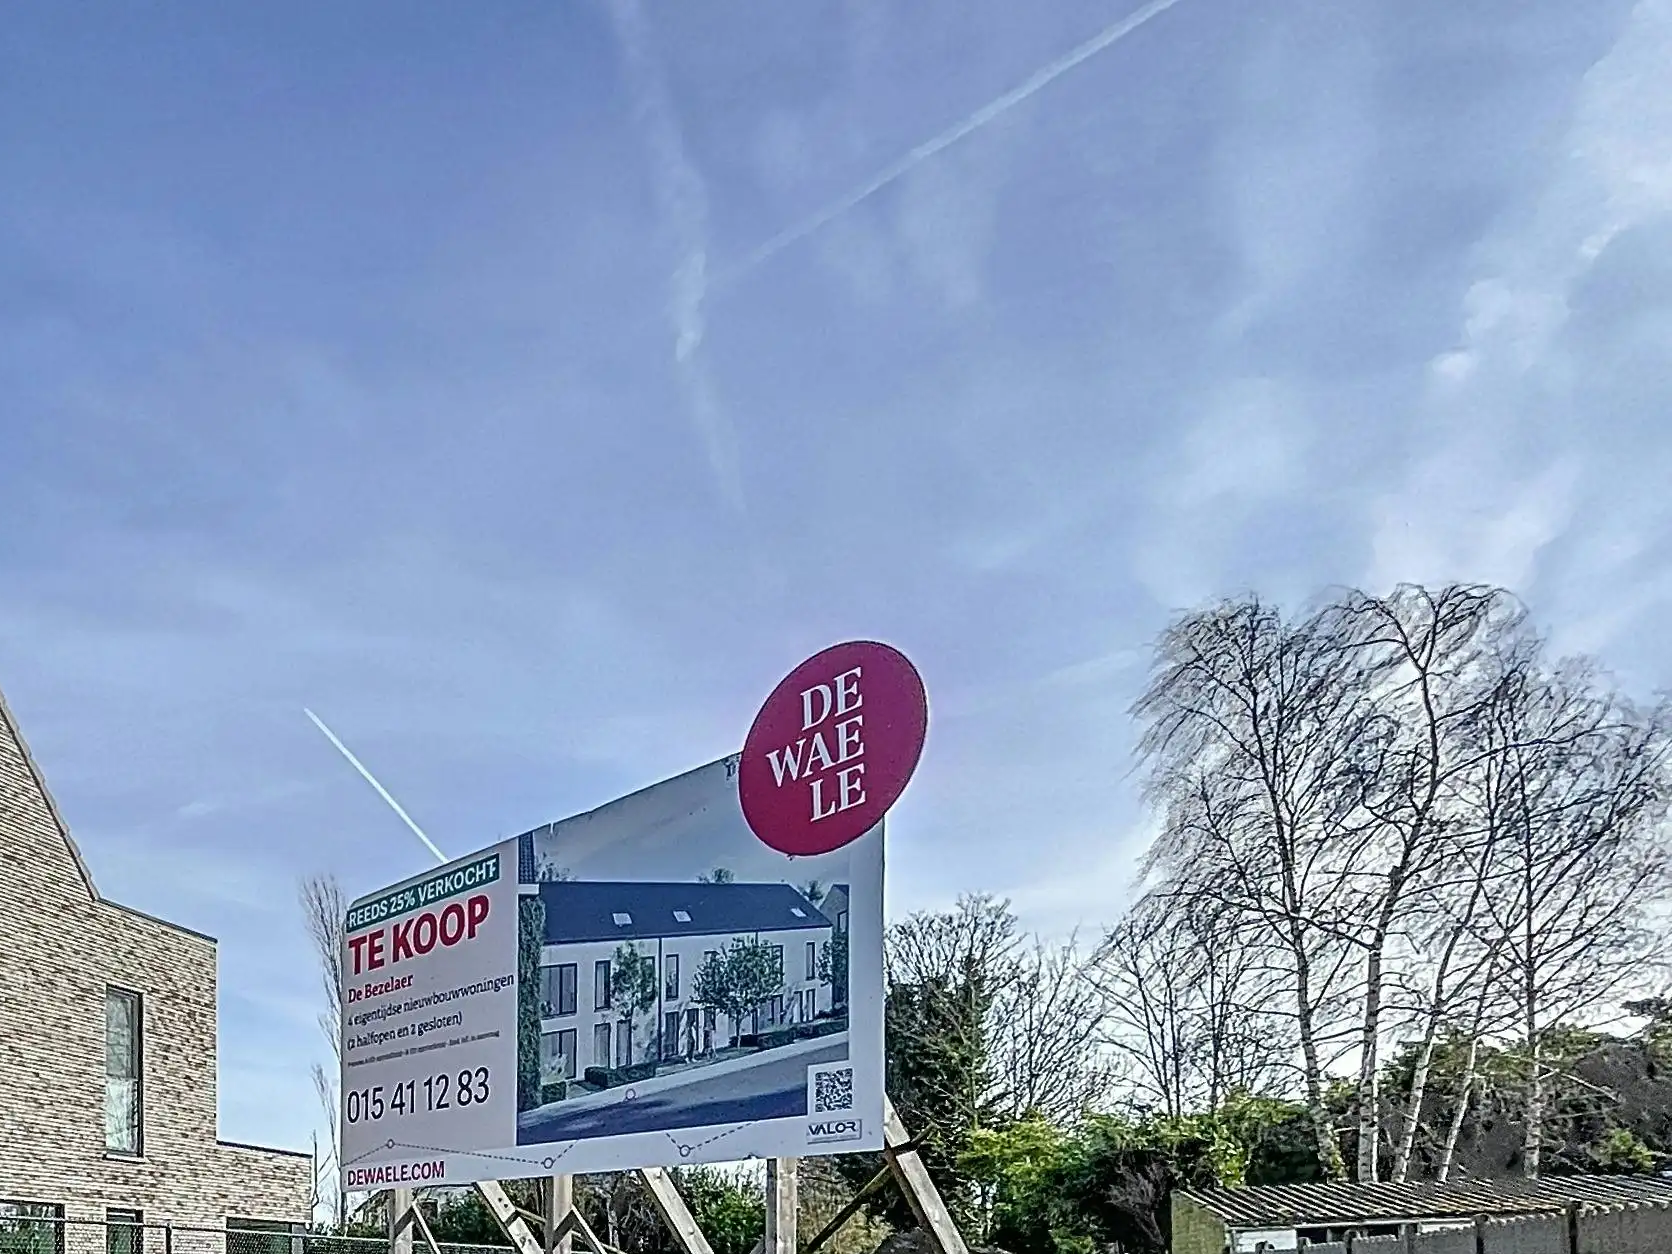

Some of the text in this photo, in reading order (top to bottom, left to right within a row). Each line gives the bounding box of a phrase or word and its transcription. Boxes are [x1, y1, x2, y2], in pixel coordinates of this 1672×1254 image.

[800, 666, 863, 731] DE
[766, 715, 865, 788] WAE
[810, 763, 866, 822] LE
[349, 859, 497, 928] REEDS 25% VERKOCHT
[348, 895, 490, 975] TE KOOP
[348, 974, 413, 1003] De Bezelaer
[354, 1003, 402, 1026] eigentijdse
[404, 974, 515, 1011] nieuwbouwwoningen
[357, 1029, 396, 1048] halfopen
[397, 1027, 409, 1039] en
[411, 1025, 417, 1035] 2
[418, 1011, 463, 1036] gesloten)
[347, 1067, 490, 1124] 015 41 12 83
[809, 1121, 856, 1136] VALOR
[348, 1161, 445, 1186] DEWAELE.COM
